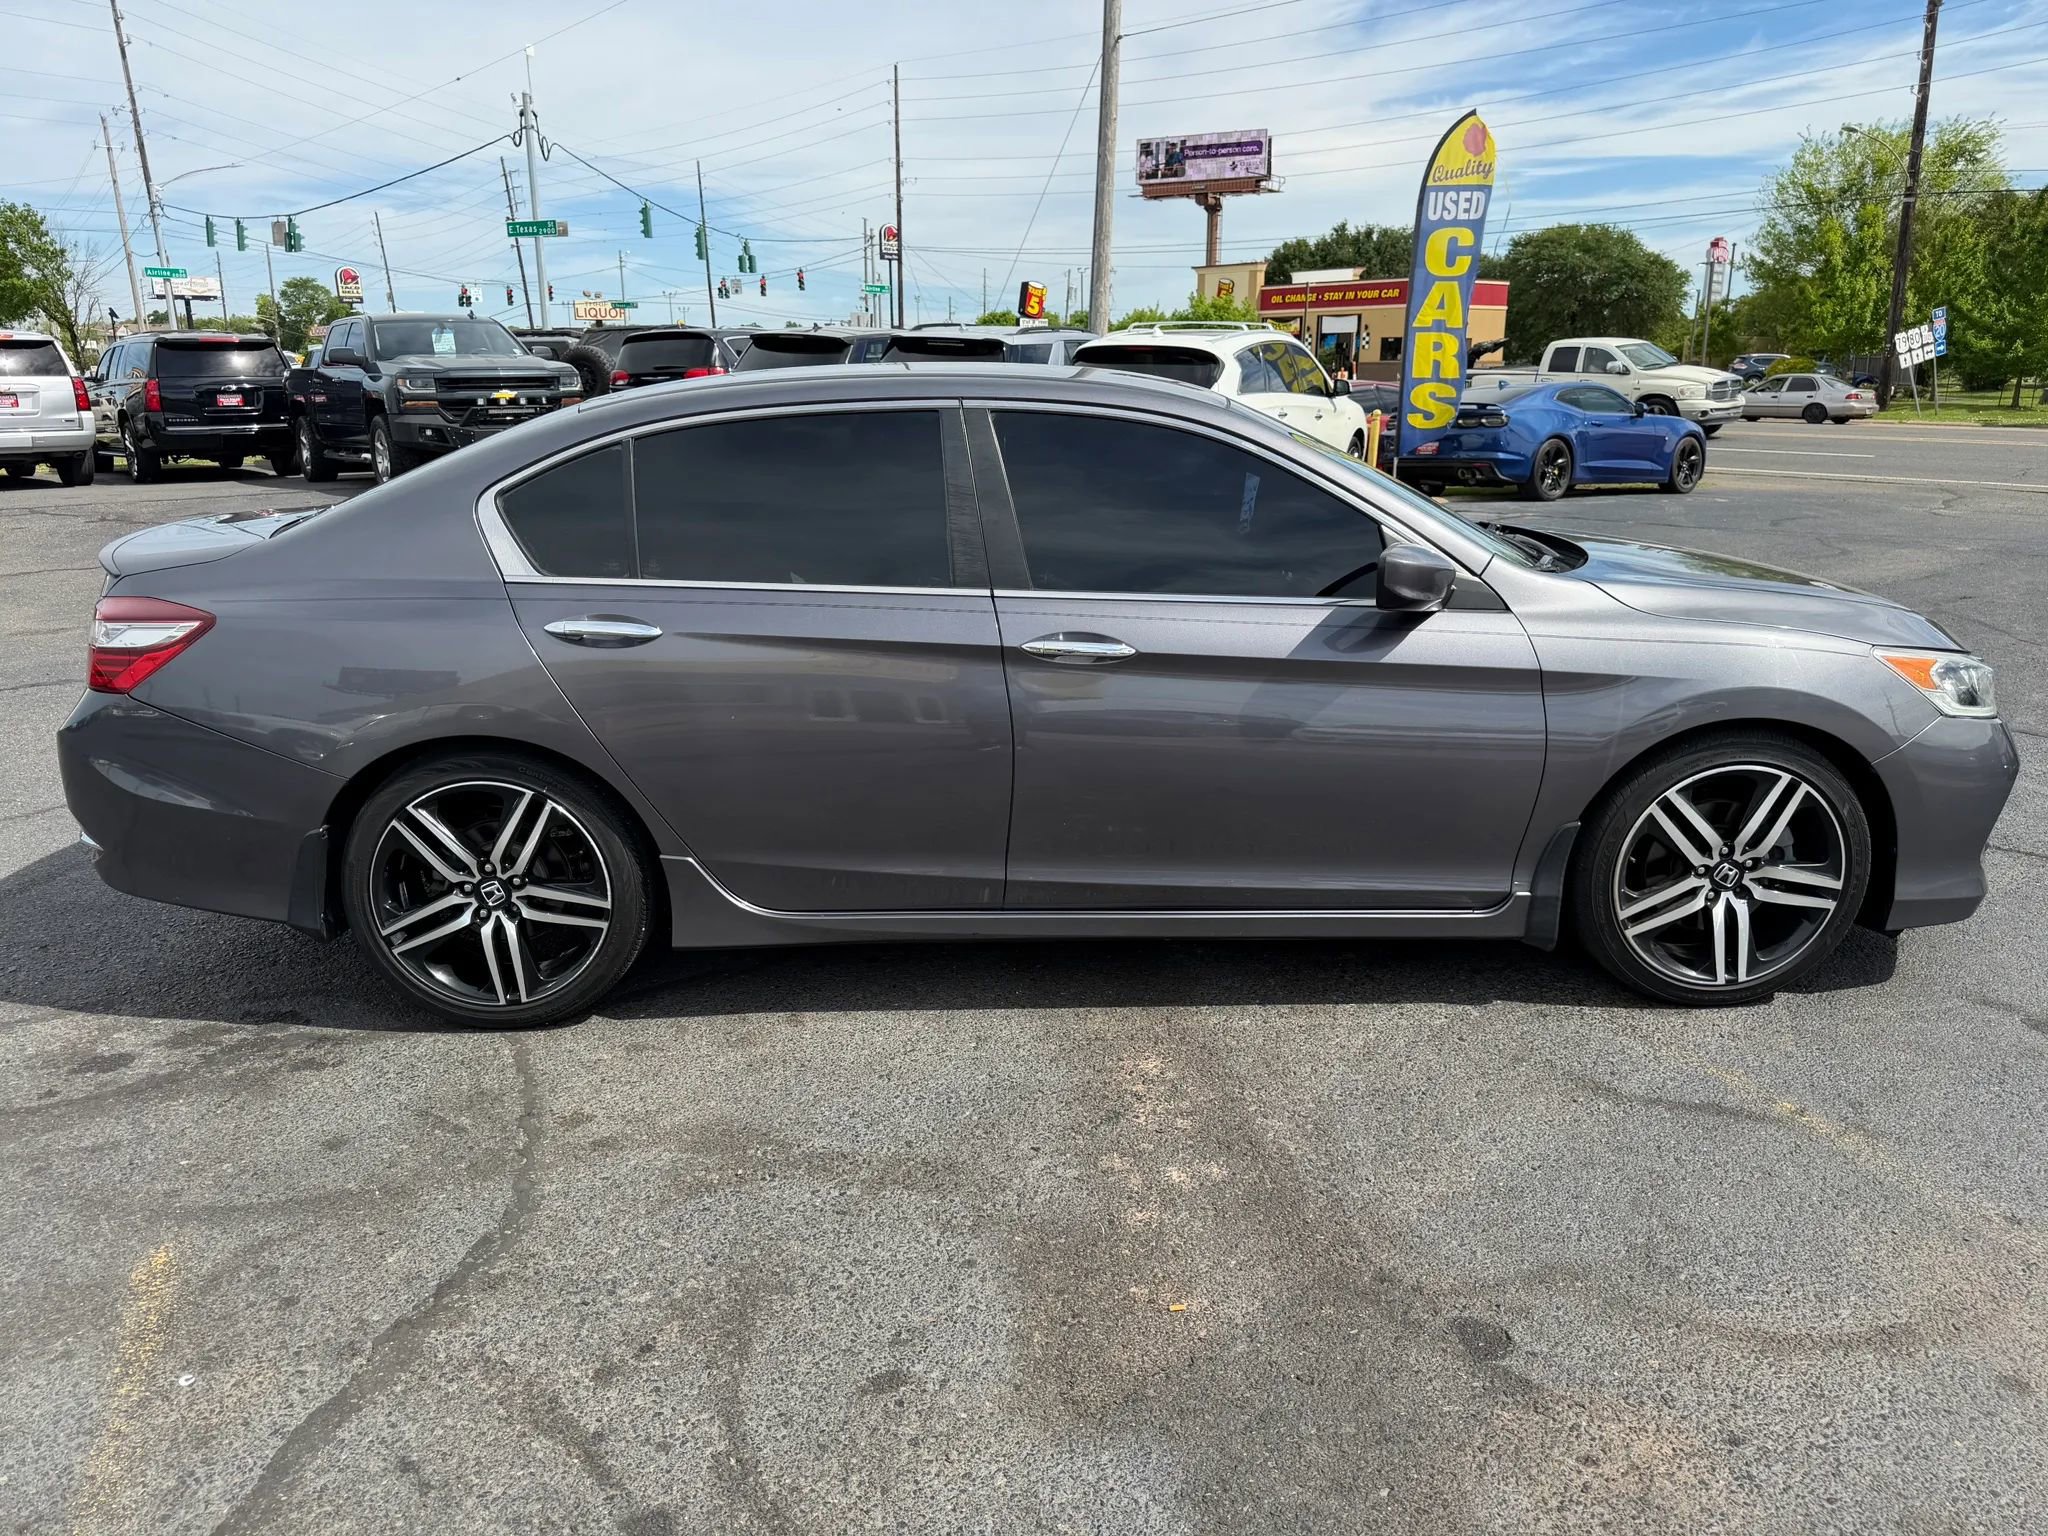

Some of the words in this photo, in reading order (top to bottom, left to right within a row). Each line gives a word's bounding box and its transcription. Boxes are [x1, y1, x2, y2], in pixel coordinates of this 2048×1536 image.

[1432, 159, 1494, 183] Quality
[1427, 190, 1486, 221] USED
[516, 225, 538, 234] Texas
[538, 227, 556, 235] 2900
[1271, 294, 1283, 303] OIL
[1285, 293, 1317, 302] CHANGE
[1323, 292, 1343, 301] STAY
[1357, 290, 1379, 299] YOUR
[1381, 288, 1400, 298] CAR
[1027, 295, 1040, 315] 5
[1936, 310, 1943, 318] TO
[1406, 227, 1475, 430] CARS
[1934, 325, 1945, 338] 20
[1896, 336, 1907, 349] 79
[1910, 332, 1920, 346] 80
